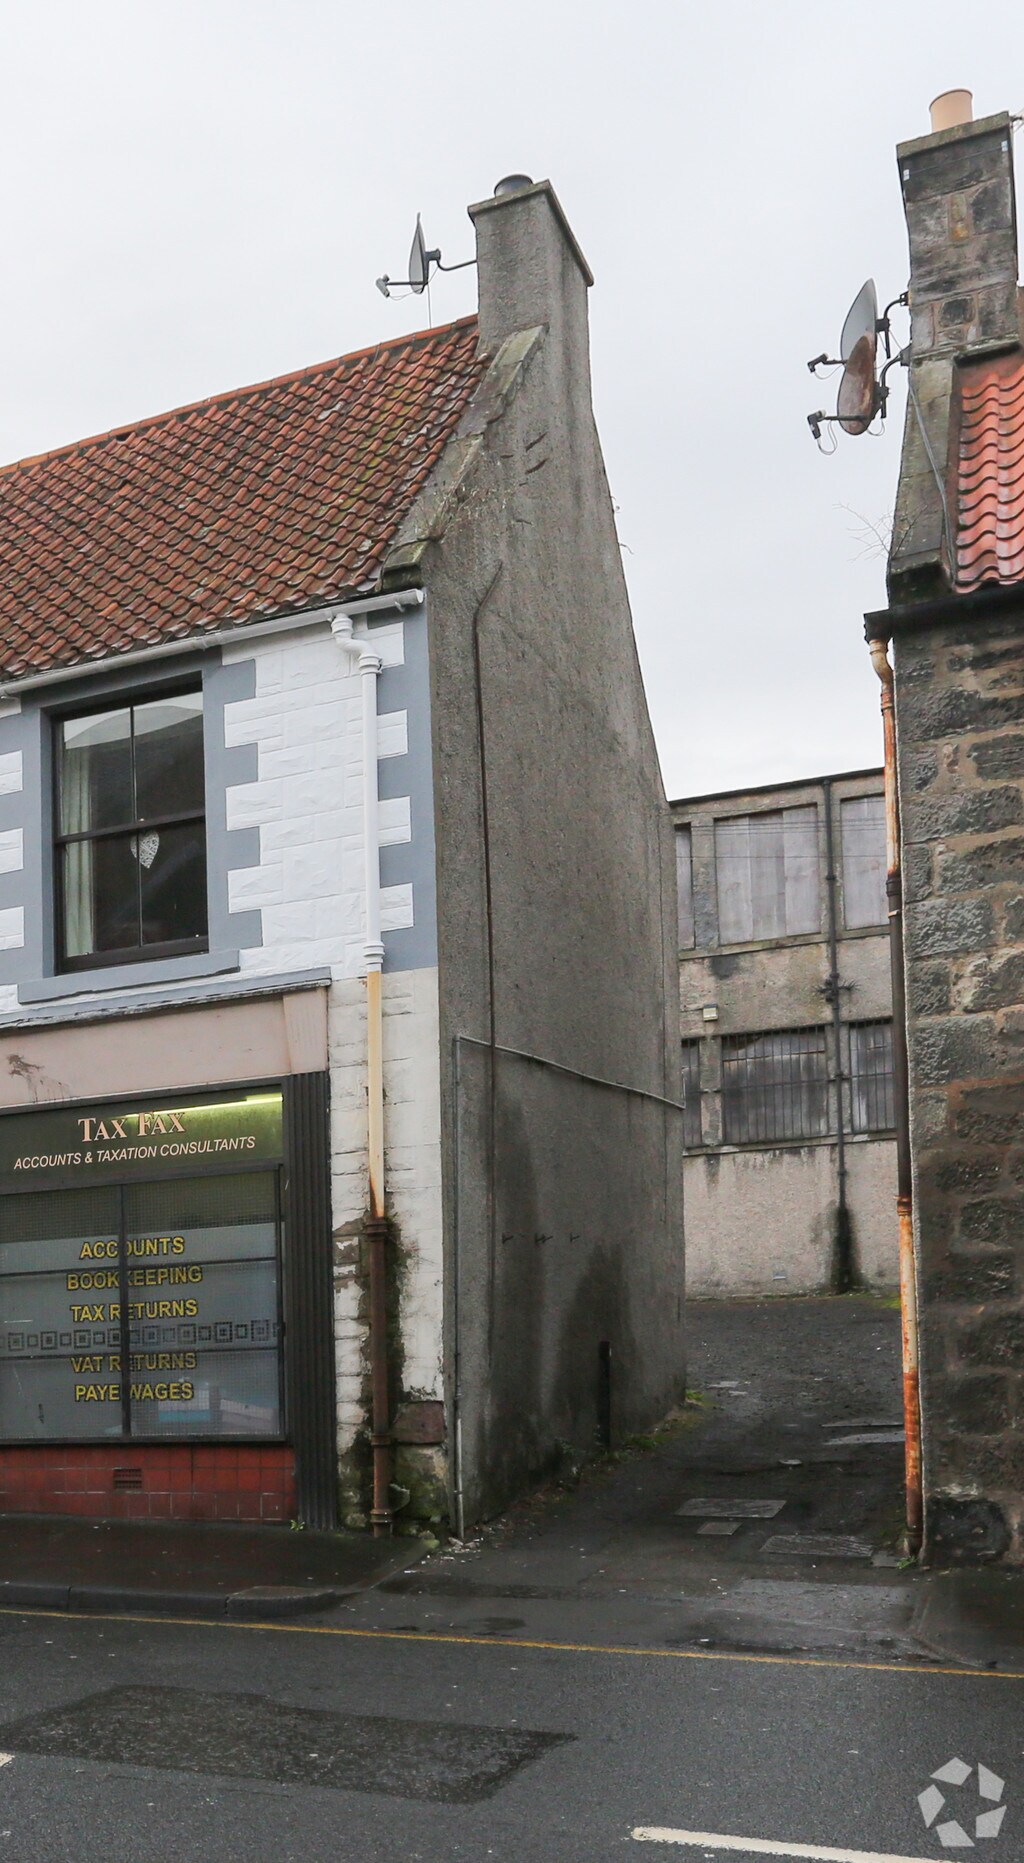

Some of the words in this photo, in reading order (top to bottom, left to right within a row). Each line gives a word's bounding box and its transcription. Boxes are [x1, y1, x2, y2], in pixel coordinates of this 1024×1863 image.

[14, 1152, 82, 1170] ACCOUNTS
[84, 1151, 94, 1164] &
[97, 1145, 158, 1163] TAXATION
[160, 1136, 256, 1157] CONSULTANTS
[71, 1304, 105, 1323] TAX
[71, 1356, 104, 1373] VAT
[75, 1384, 121, 1401] PAYE
